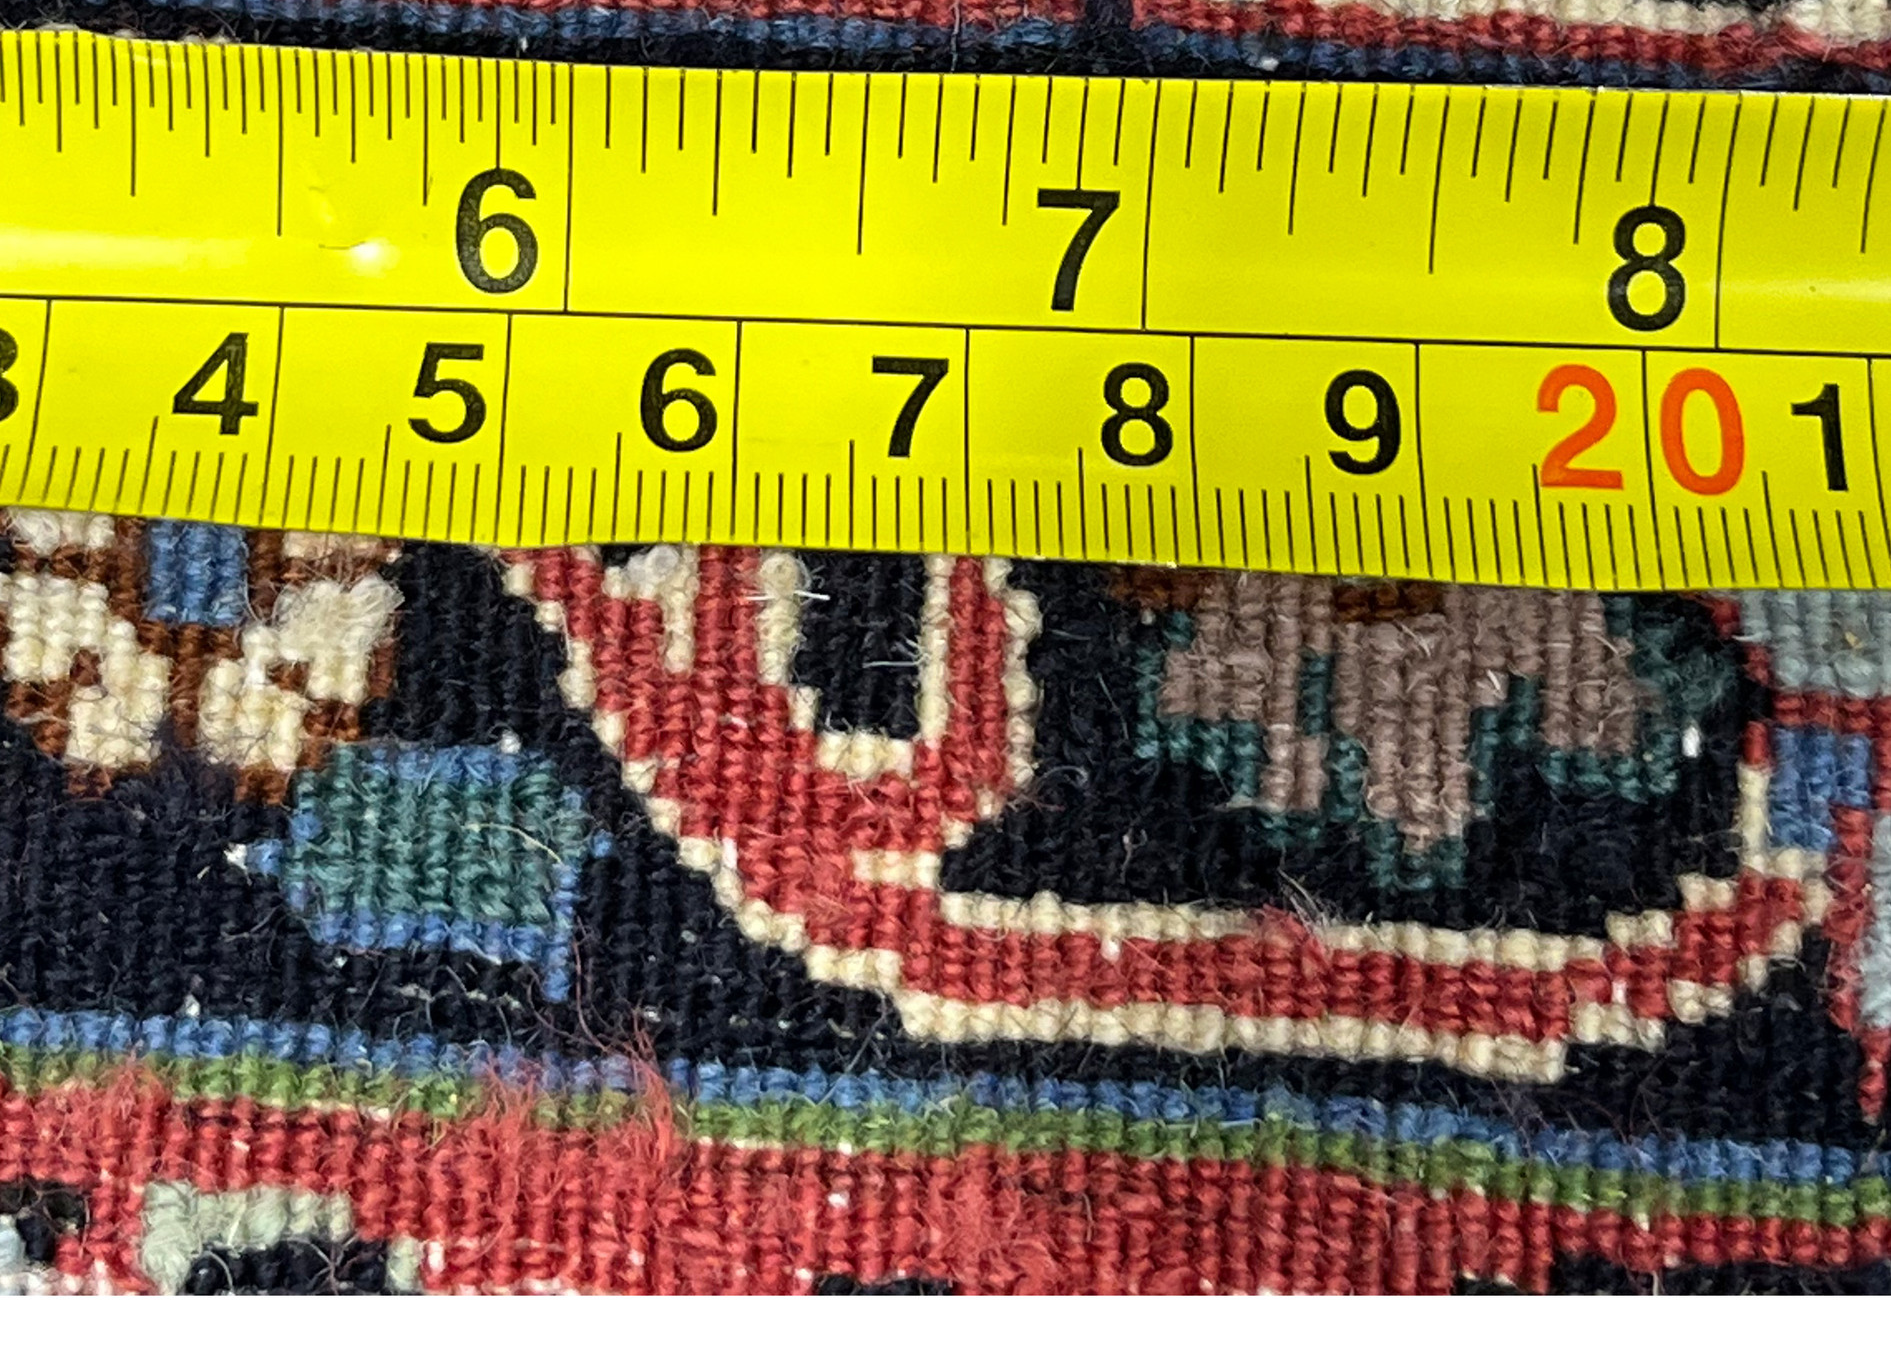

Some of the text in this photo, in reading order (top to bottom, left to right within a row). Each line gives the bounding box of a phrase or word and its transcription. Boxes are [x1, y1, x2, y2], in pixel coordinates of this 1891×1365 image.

[455, 167, 1686, 332] 6 7 8
[172, 332, 1849, 496] 4 5 6 7 8 9 20 1
